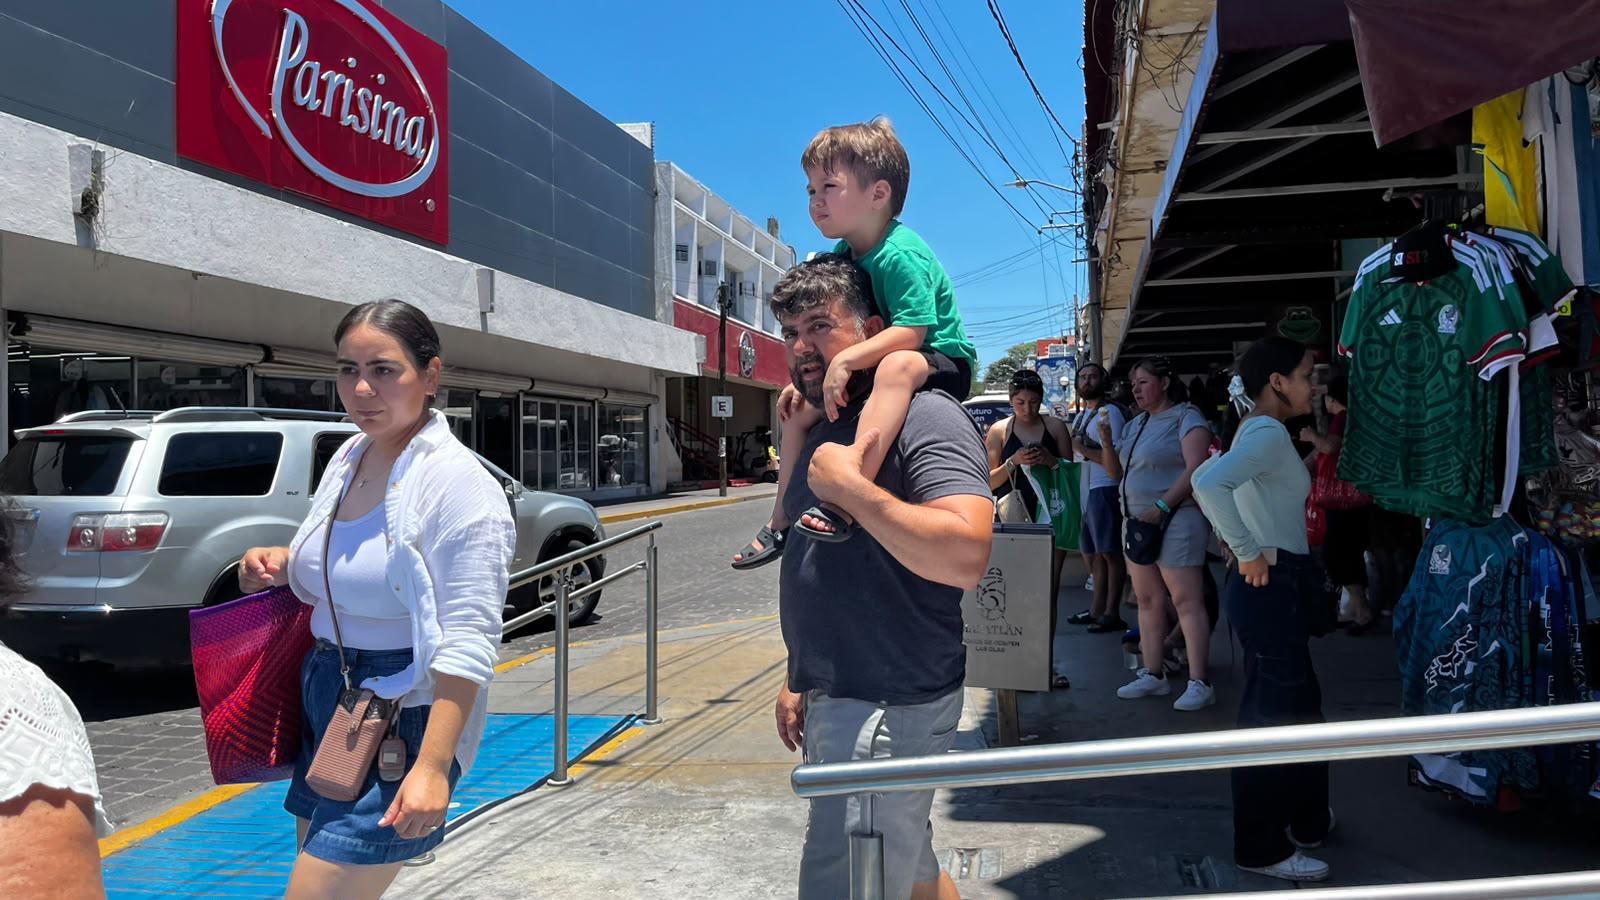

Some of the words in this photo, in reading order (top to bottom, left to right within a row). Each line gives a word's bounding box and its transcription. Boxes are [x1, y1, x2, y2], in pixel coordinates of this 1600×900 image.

[272, 8, 426, 160] Parisina
[718, 401, 726, 412] E
[968, 407, 992, 415] futuro
